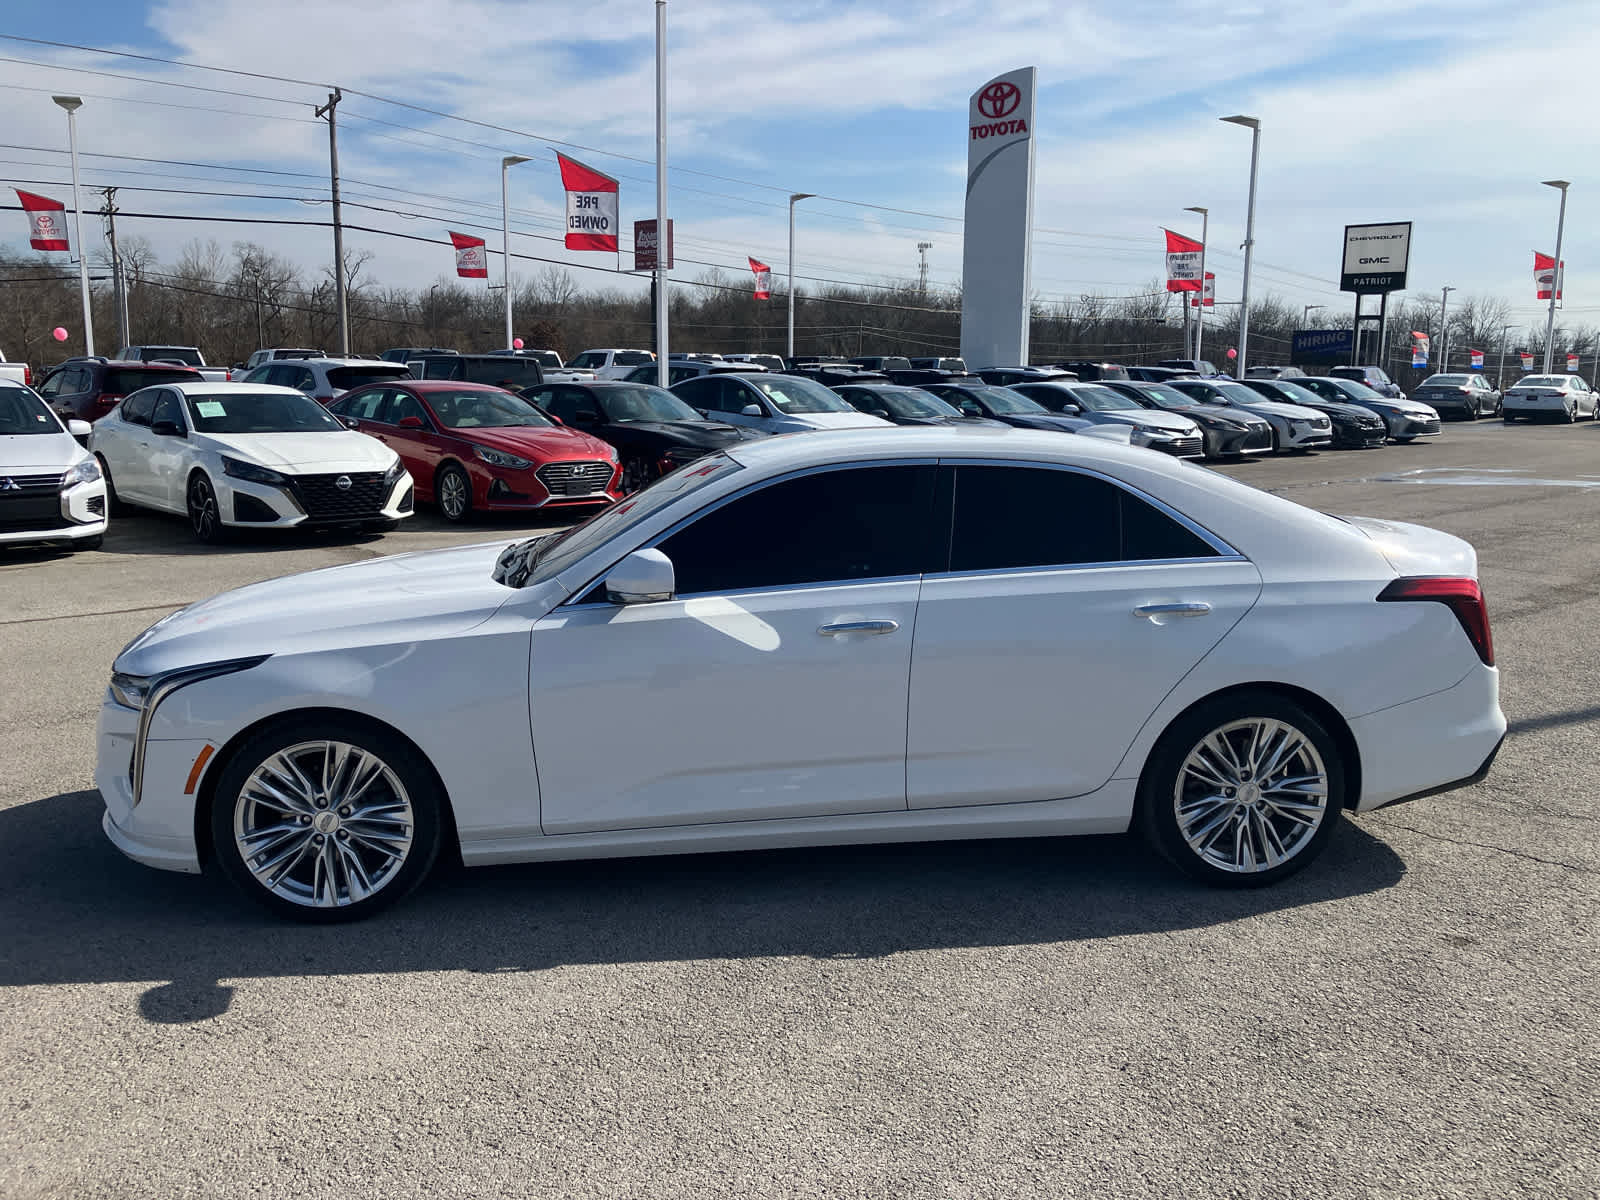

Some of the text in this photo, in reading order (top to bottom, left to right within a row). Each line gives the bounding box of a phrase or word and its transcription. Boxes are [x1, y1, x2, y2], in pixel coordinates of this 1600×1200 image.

[970, 119, 1027, 140] TOYOTA
[1349, 234, 1404, 242] CHEVROLET
[1358, 256, 1390, 265] GMC
[1353, 277, 1392, 286] PATRIOT
[1297, 331, 1346, 348] HIRING
